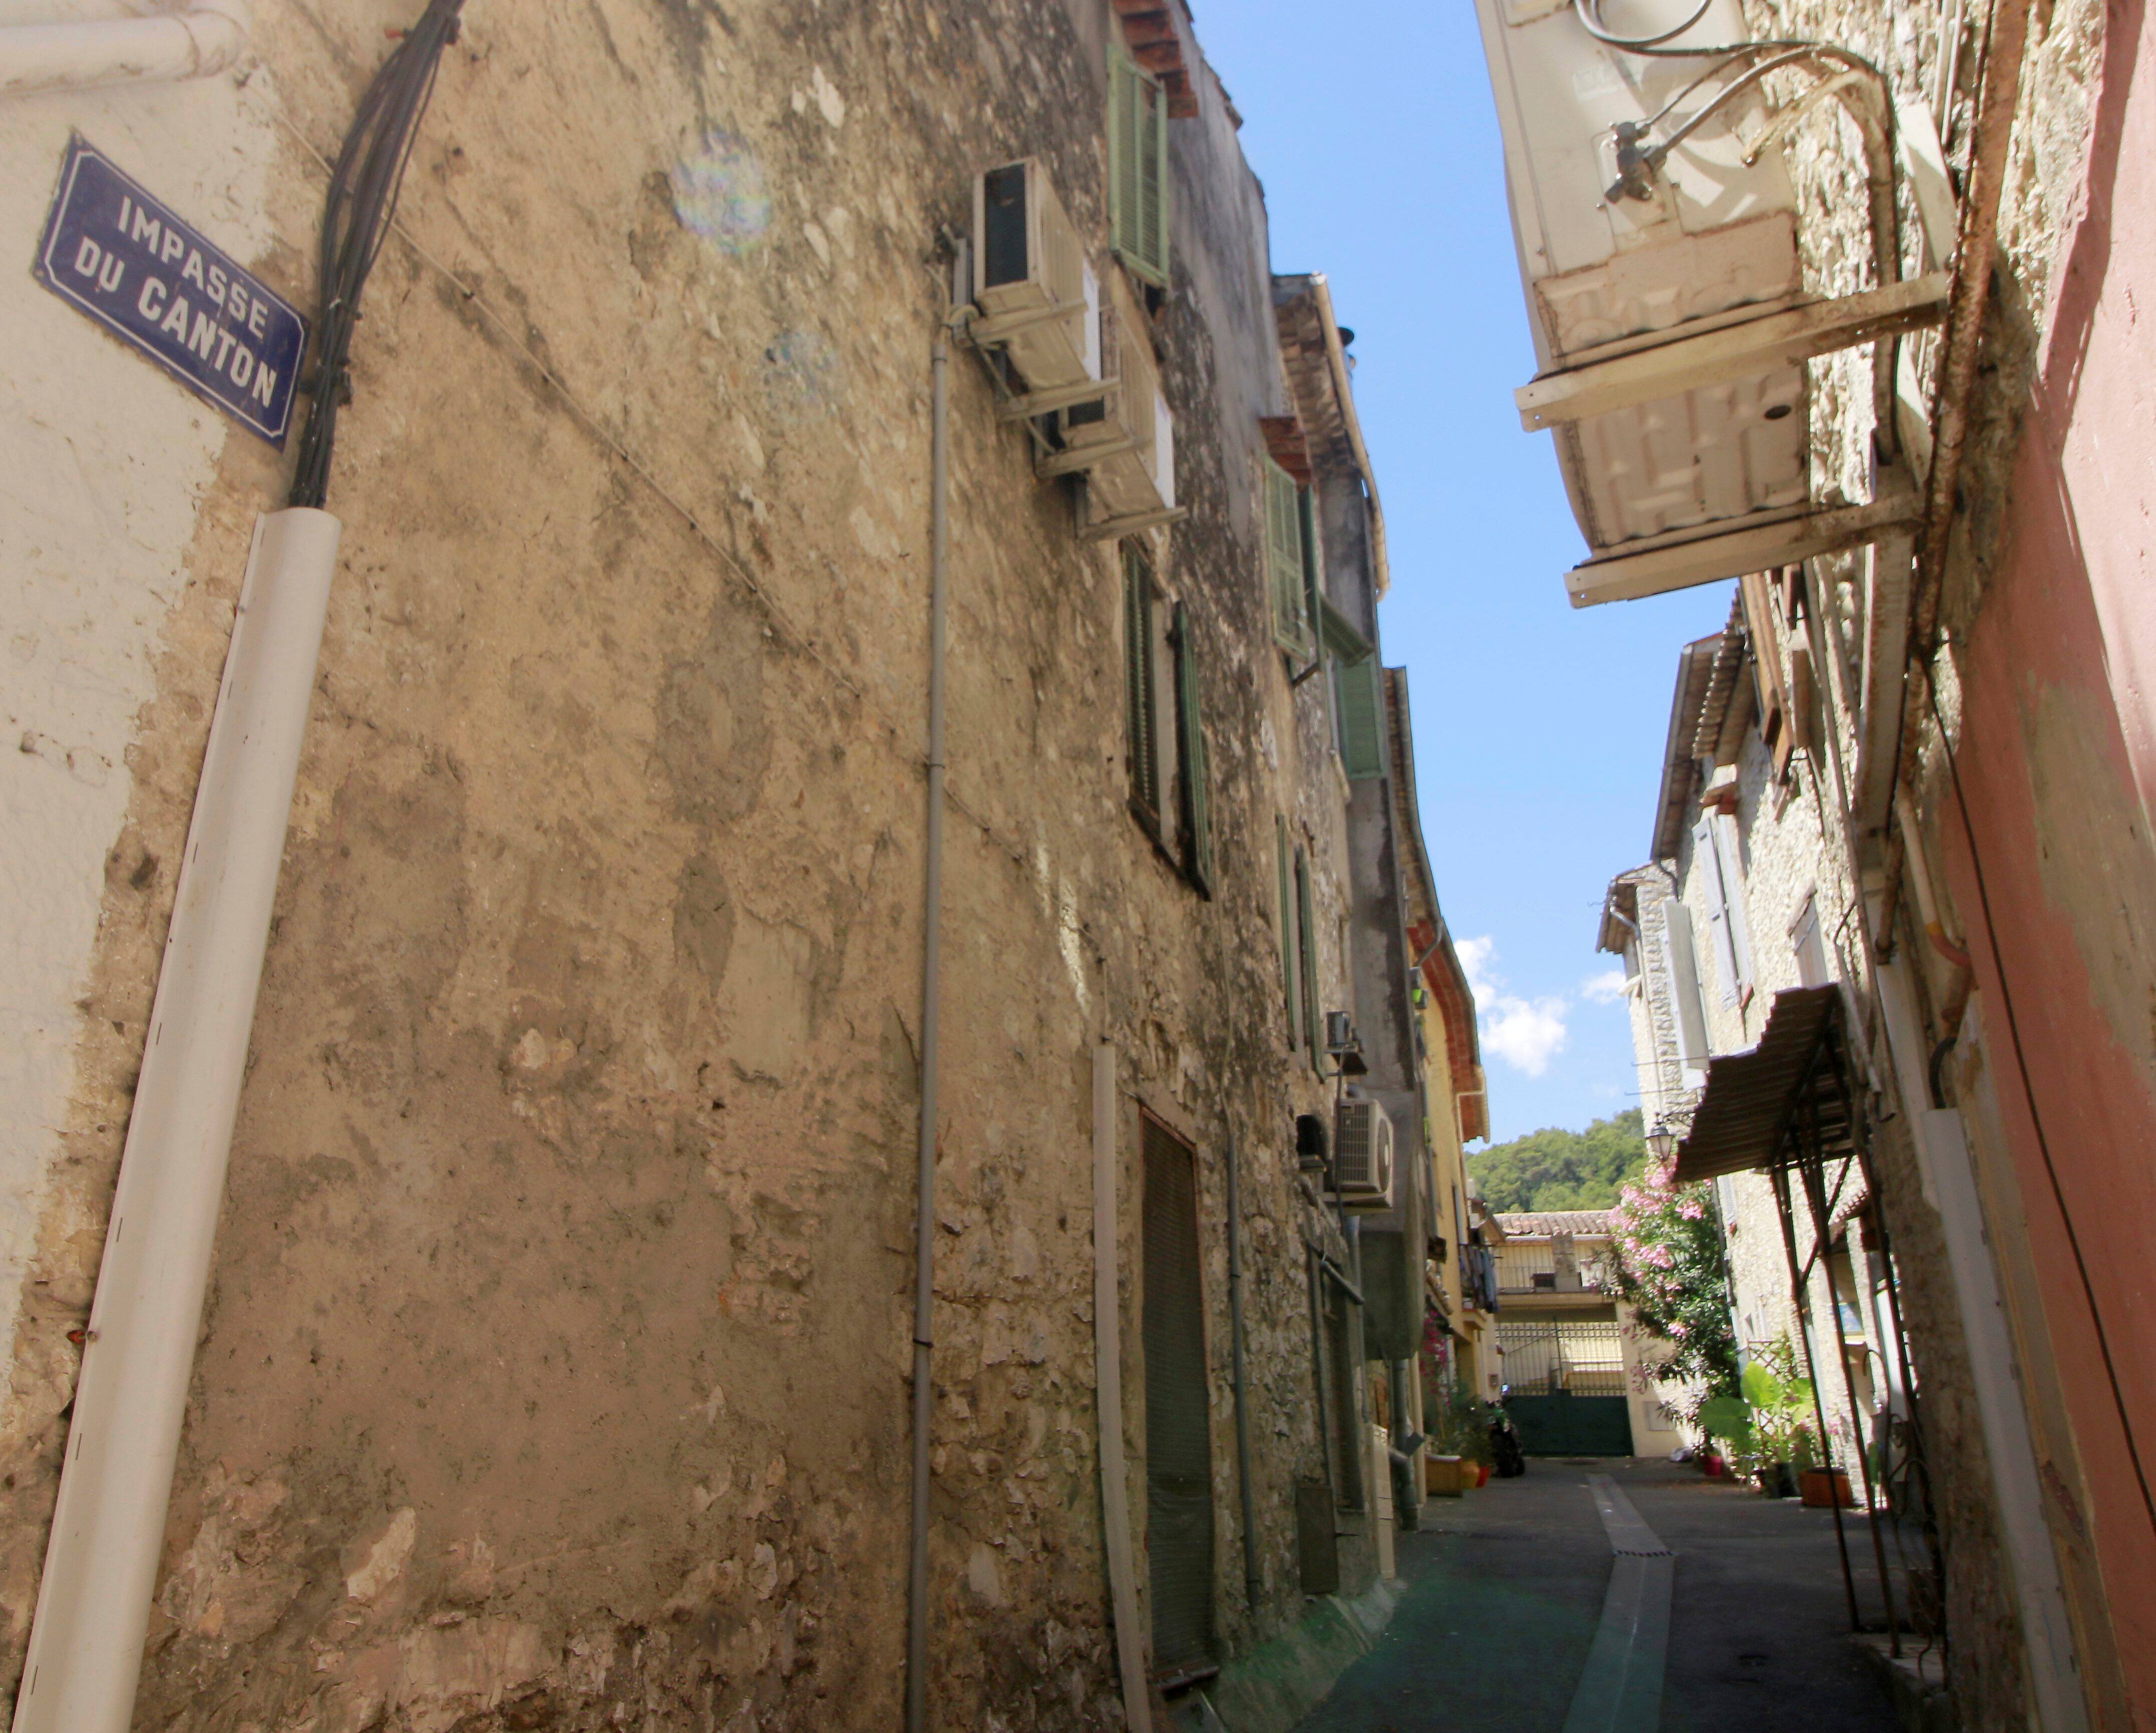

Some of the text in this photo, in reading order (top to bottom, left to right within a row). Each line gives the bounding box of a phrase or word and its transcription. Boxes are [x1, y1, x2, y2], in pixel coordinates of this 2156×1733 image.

[75, 236, 277, 408] DU CANTON
[117, 196, 268, 339] IMPASSE
